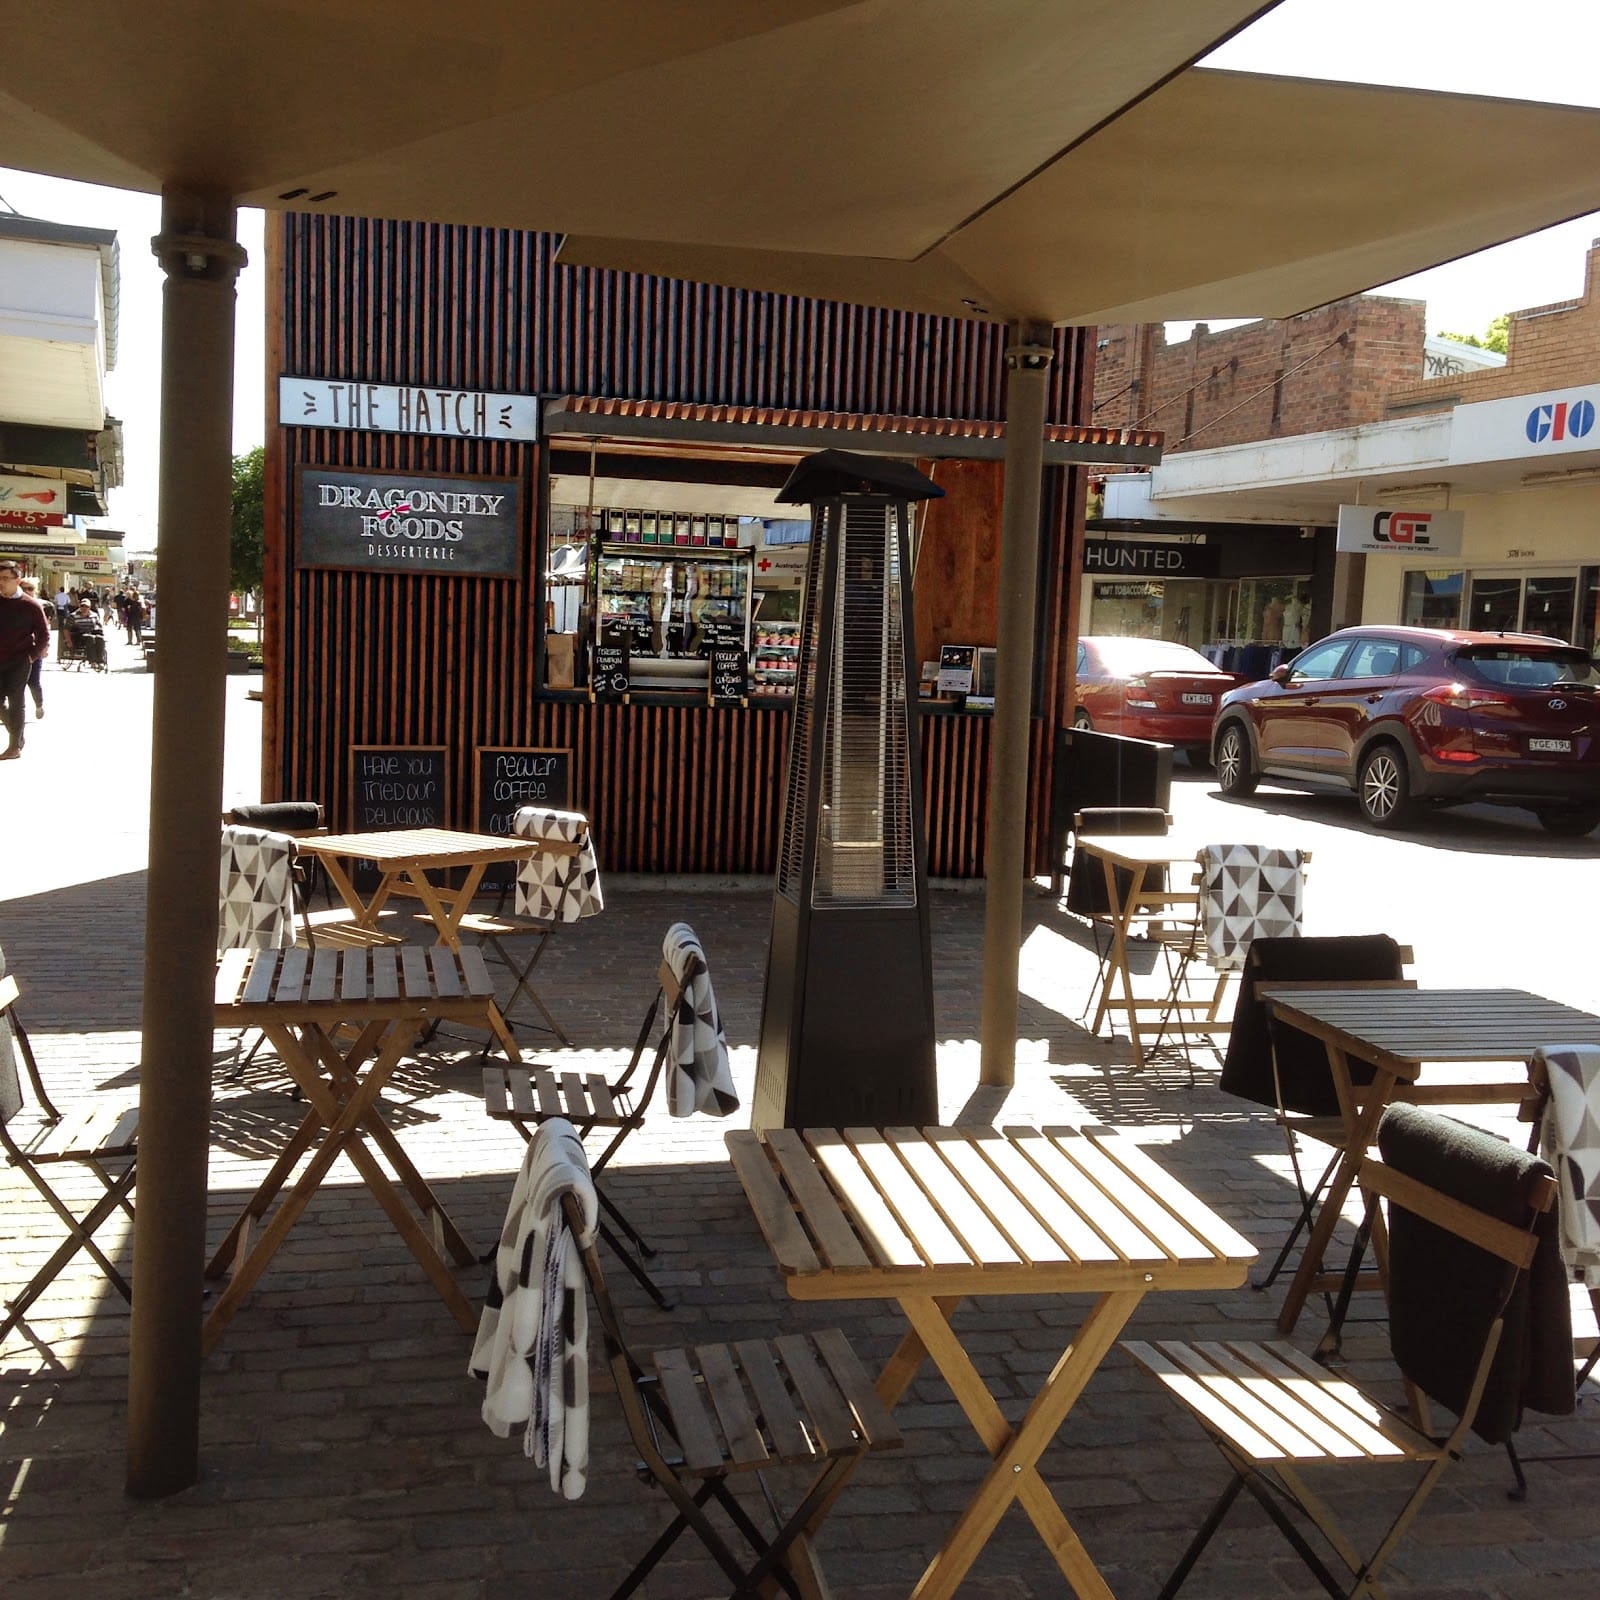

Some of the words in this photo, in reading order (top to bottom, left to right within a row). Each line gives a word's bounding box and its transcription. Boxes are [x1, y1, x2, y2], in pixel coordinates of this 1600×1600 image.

[328, 384, 380, 429] THE
[398, 387, 487, 436] HATCH
[1526, 400, 1595, 443] GIO
[318, 484, 504, 516] DRAGONFLY
[361, 515, 463, 542] FOODS
[1373, 511, 1432, 544] CGE
[368, 543, 455, 560] DESSERTERIE
[1086, 547, 1185, 569] HUNTED.
